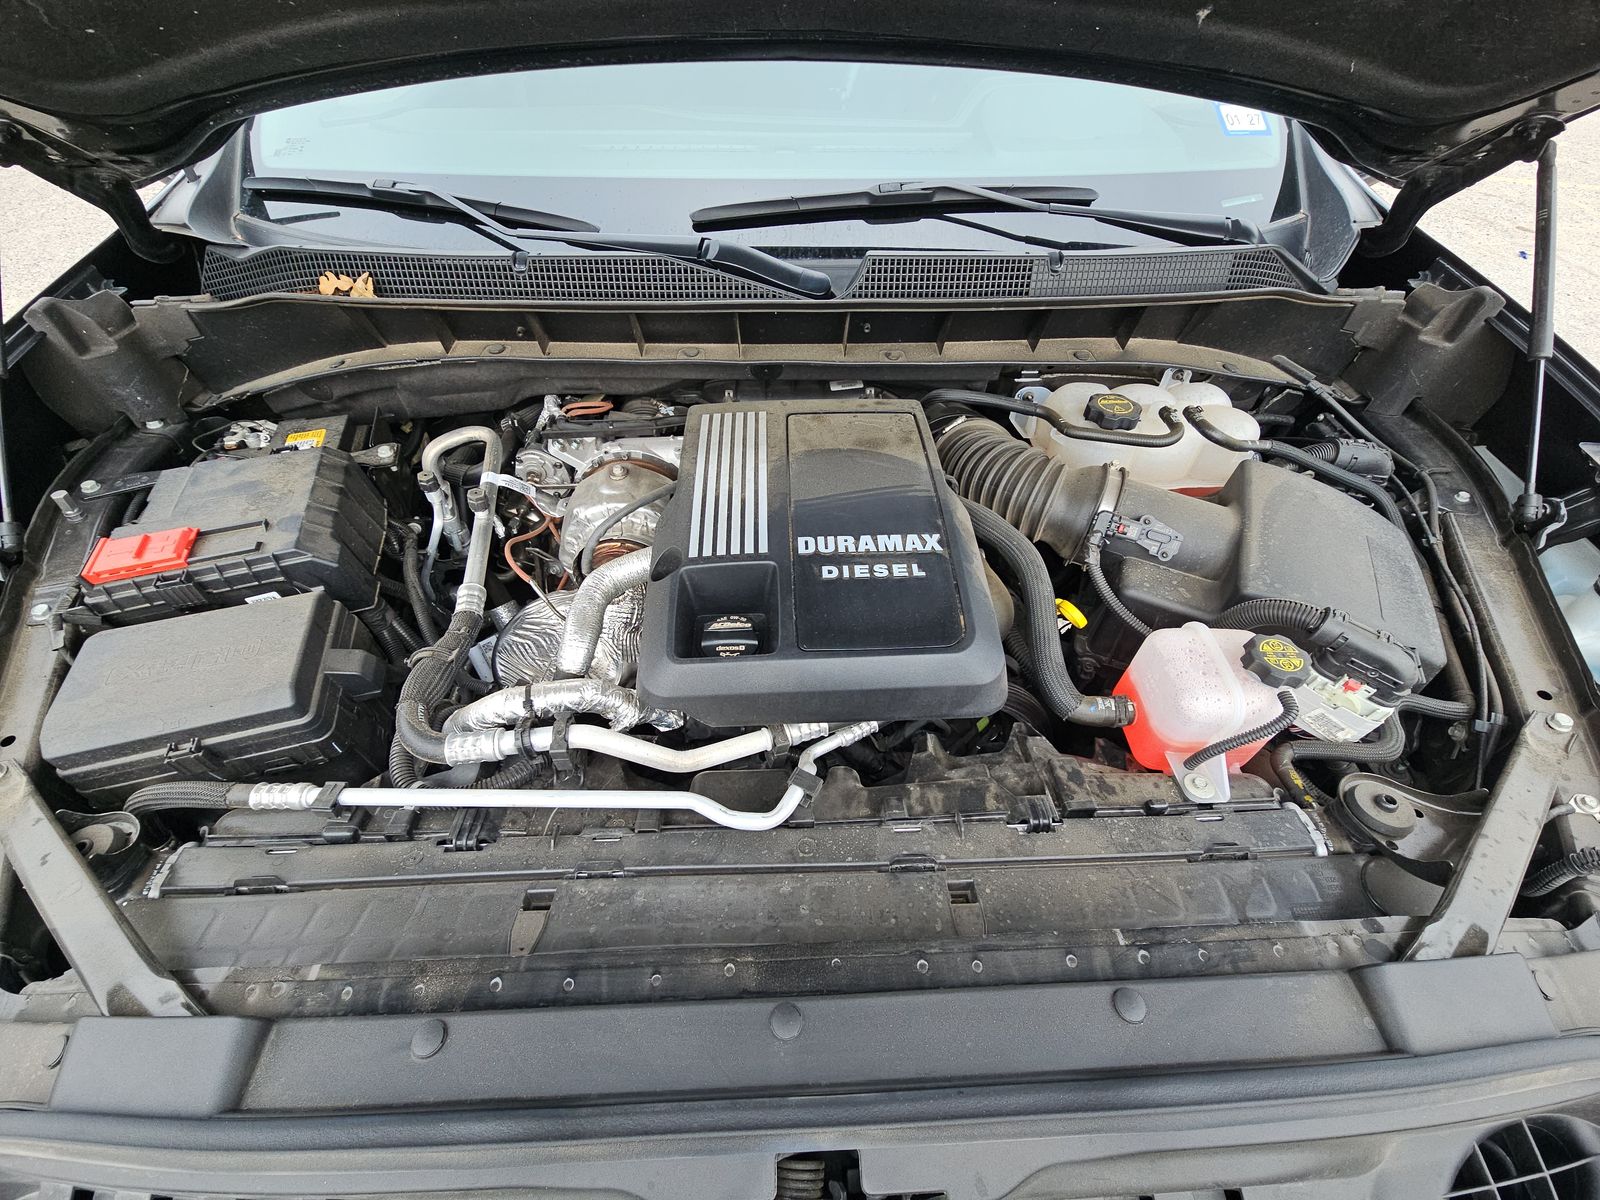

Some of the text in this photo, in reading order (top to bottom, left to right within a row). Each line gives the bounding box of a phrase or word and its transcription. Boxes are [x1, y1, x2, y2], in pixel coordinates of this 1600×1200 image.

[1225, 112, 1260, 126] 01 27
[797, 533, 944, 555] DURAMAX
[821, 563, 927, 580] DIESEL
